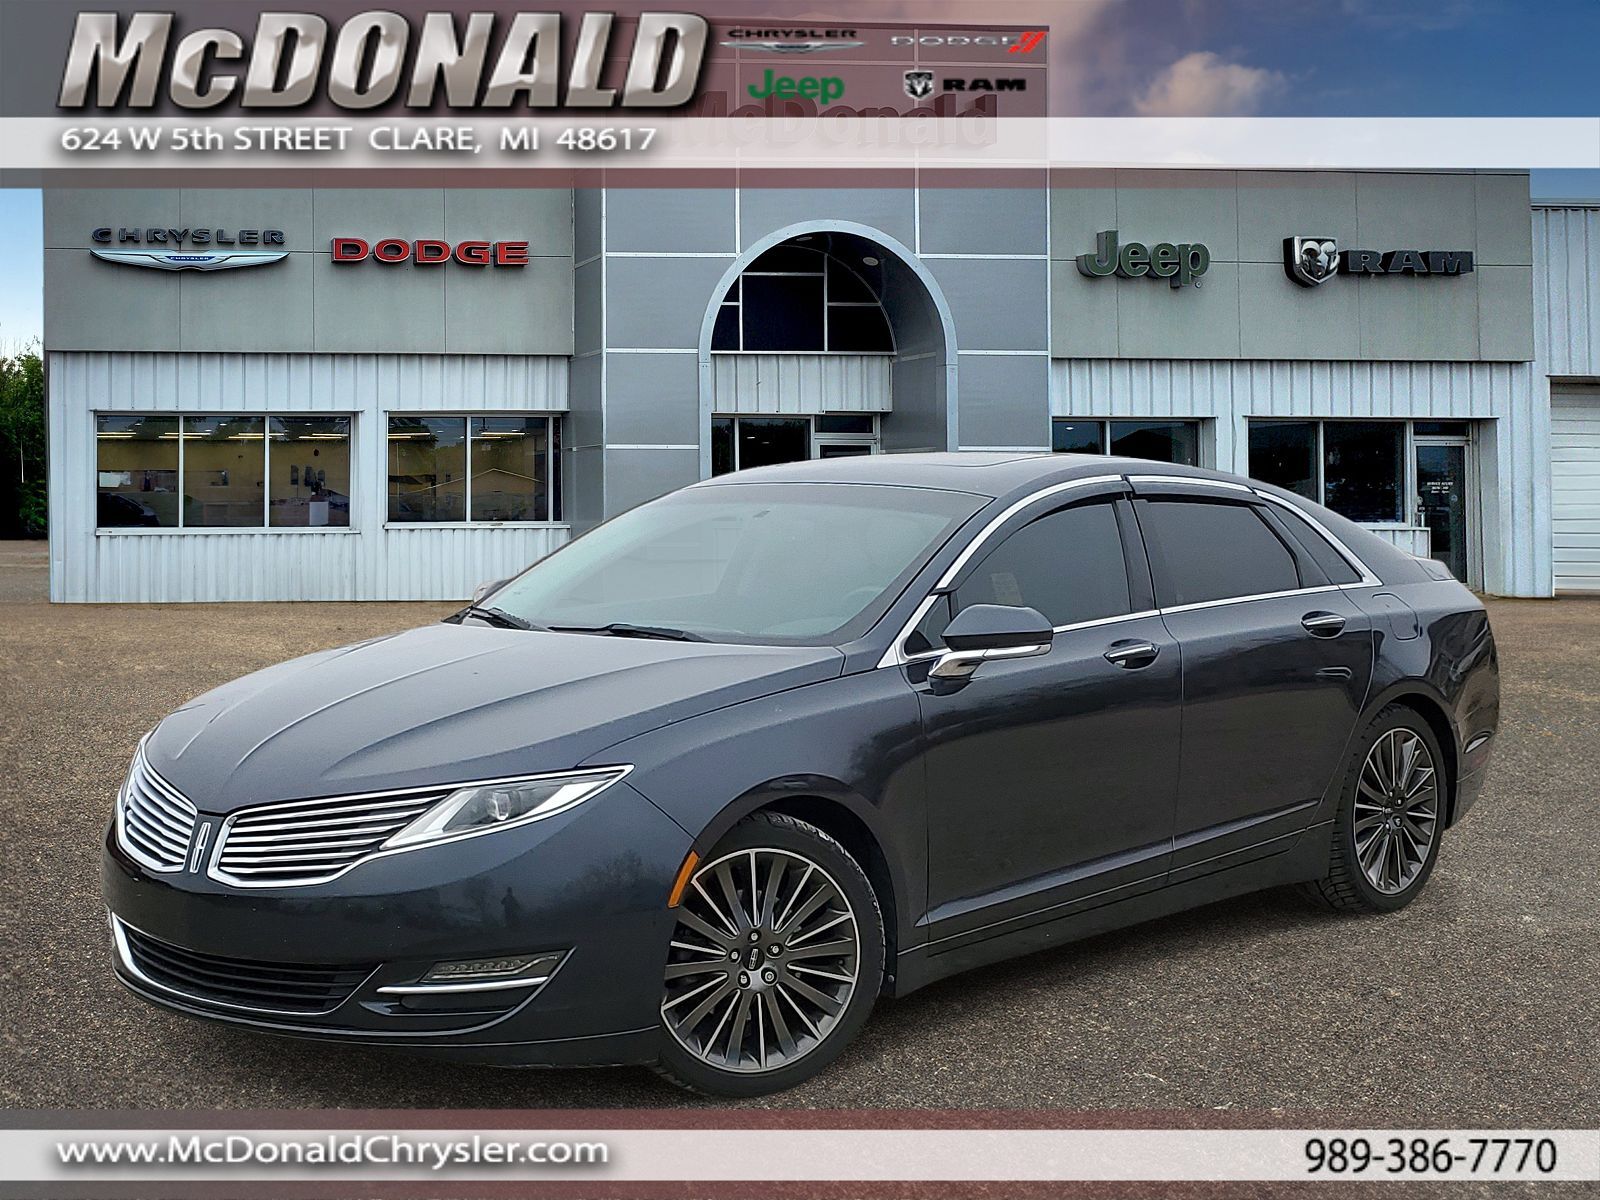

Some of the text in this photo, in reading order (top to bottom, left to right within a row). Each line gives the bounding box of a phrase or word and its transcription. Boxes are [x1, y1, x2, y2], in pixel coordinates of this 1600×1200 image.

[92, 227, 286, 244] CHRYSLER
[331, 237, 530, 267] DODGE
[1077, 230, 1211, 288] Jeep
[1343, 249, 1474, 274] RAM
